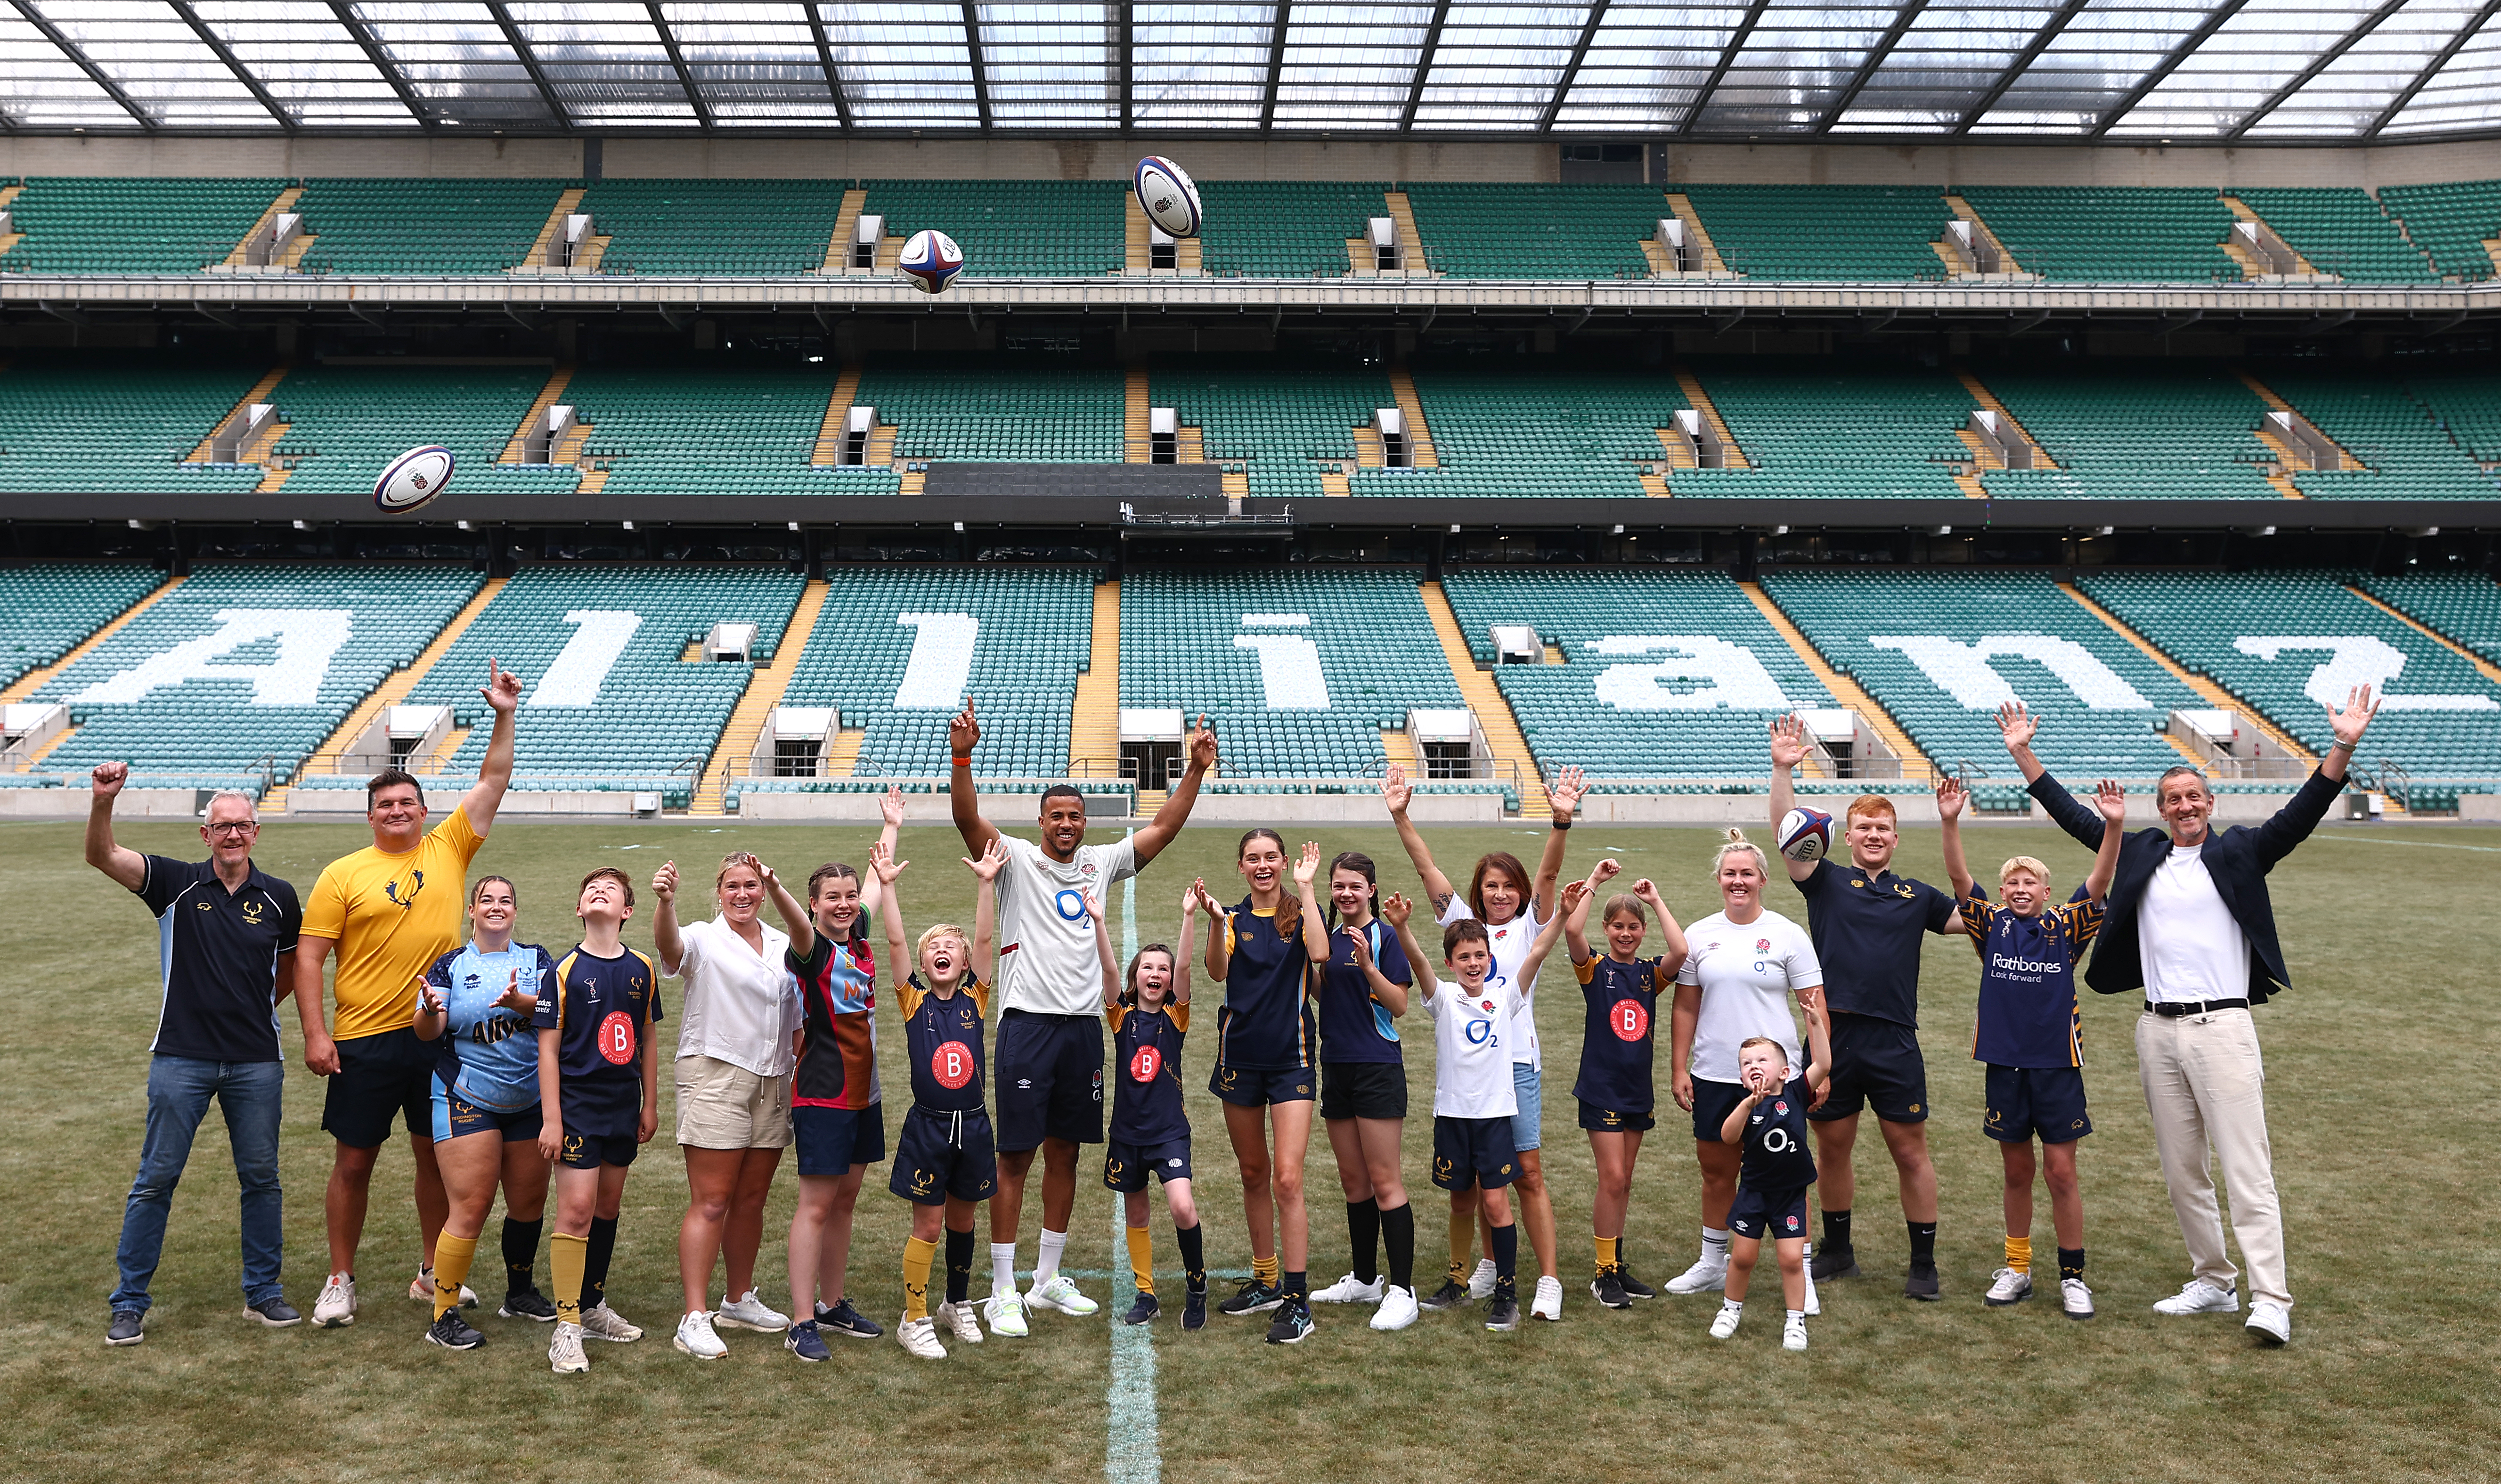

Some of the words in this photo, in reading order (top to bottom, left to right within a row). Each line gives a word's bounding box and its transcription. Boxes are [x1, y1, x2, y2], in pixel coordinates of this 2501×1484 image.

[1992, 953, 2061, 973] Rathbones
[2009, 972, 2042, 983] forward
[472, 1015, 531, 1044] Alive
[1624, 1009, 1636, 1031] B
[614, 1024, 627, 1052] B
[959, 1044, 971, 1058] HOUSE
[947, 1052, 962, 1077] B
[1142, 1054, 1152, 1074] B
[963, 1067, 972, 1083] YOURS
